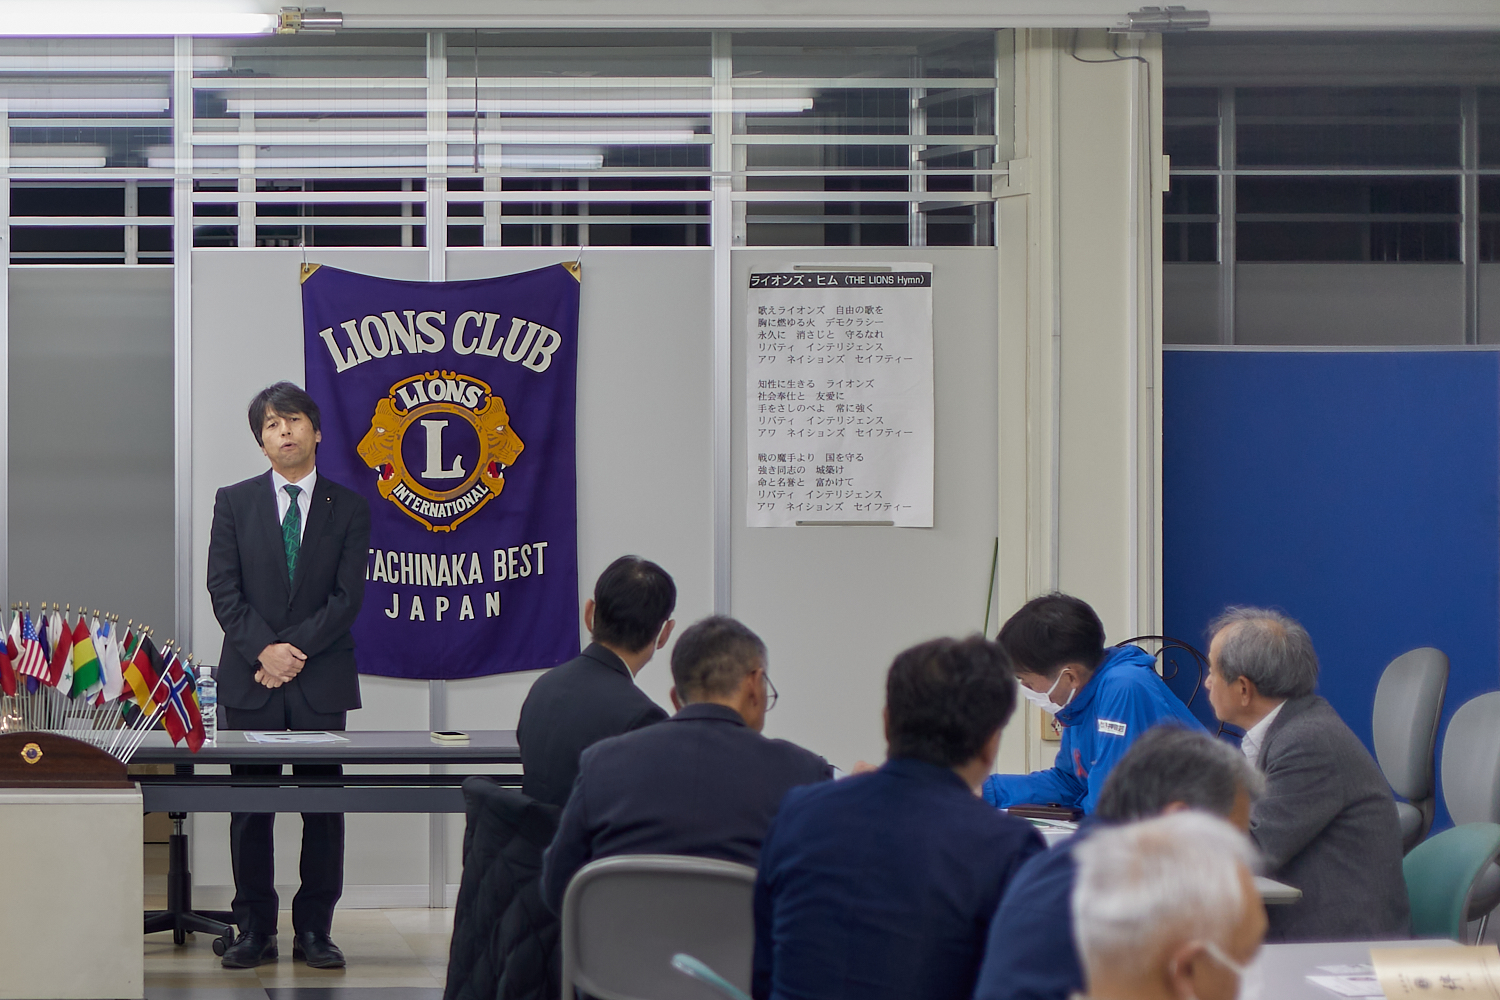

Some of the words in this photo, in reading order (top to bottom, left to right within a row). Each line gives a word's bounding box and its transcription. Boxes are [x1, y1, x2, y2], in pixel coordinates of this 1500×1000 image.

[750, 274, 839, 287] ライオンズ・ヒム
[868, 275, 894, 285] LIONS
[758, 305, 826, 316] 歌えライオンズ
[837, 305, 884, 316] 自由の歌を
[758, 317, 816, 328] 胸に燃ゆる火
[826, 317, 884, 328] デモクラシー
[758, 329, 786, 340] 永久に
[797, 329, 835, 340] 消さじと
[845, 329, 884, 340] 守るなれ
[319, 310, 446, 373] LIONS
[452, 310, 562, 373] CLUB
[758, 342, 795, 352] リバティ
[807, 342, 884, 352] インテリジェンス
[758, 354, 777, 365] アワ
[787, 354, 846, 365] ネイションズ
[855, 354, 913, 365] セイフティー
[758, 378, 816, 389] 知性に生きる
[826, 378, 875, 389] ライオンズ
[397, 379, 483, 409] LIONS
[758, 391, 806, 402] 社会奉仕と
[816, 391, 845, 402] 友愛に
[758, 403, 826, 414] 手をさしのべよ
[836, 403, 874, 414] 常に強く
[758, 415, 795, 426] リバティ
[807, 415, 884, 426] インテリジェンス
[758, 427, 777, 438] アワ
[787, 427, 846, 438] ネイションズ
[855, 427, 913, 438] セイフティー
[421, 419, 466, 479] L
[758, 452, 815, 463] 戦の魔手より
[826, 452, 864, 463] 国を守る
[758, 464, 806, 475] 強き同志の
[816, 464, 845, 475] 城築け
[758, 477, 805, 488] 命と名誉と
[816, 477, 854, 488] 富かけて
[758, 489, 794, 500] リバティ
[806, 489, 883, 500] インテリジェンス
[393, 483, 489, 518] INTERNATIONAL
[757, 501, 776, 512] アワ
[786, 501, 845, 512] ネイションズ
[854, 501, 912, 512] セイフティー
[493, 541, 548, 582] BEST
[385, 591, 500, 621] JAPAN
